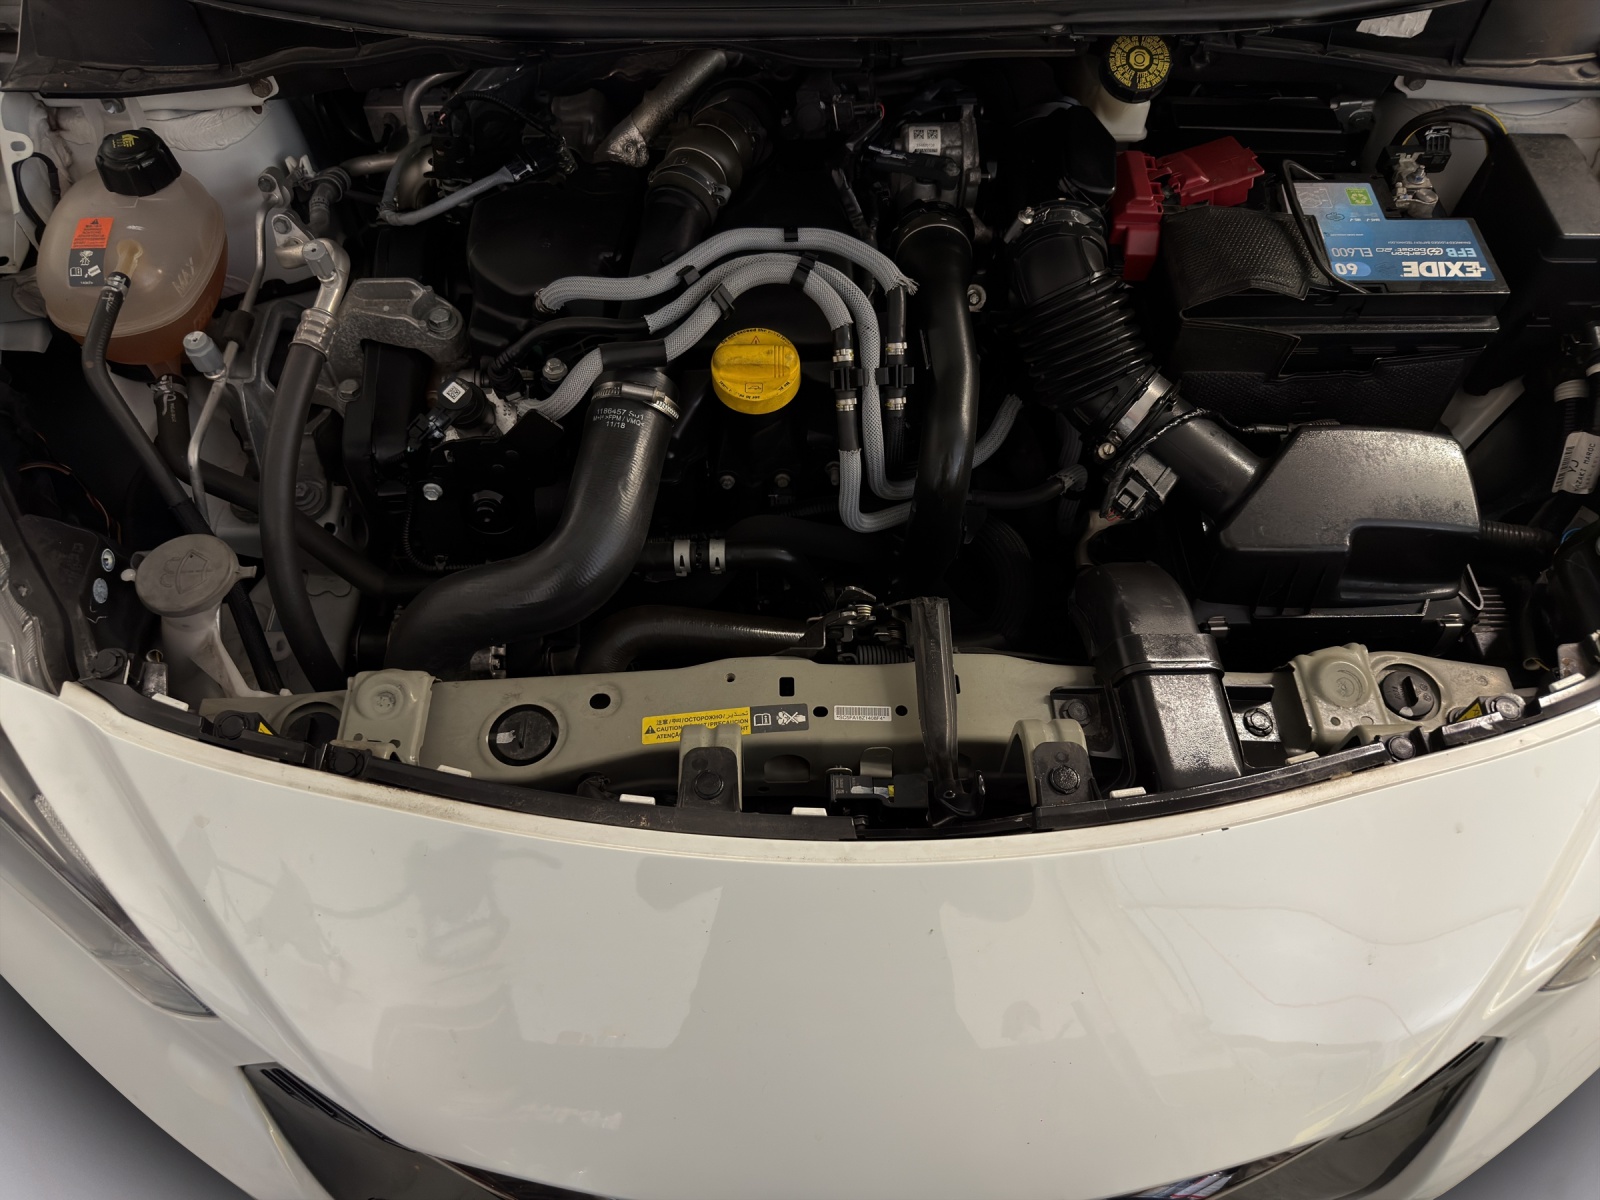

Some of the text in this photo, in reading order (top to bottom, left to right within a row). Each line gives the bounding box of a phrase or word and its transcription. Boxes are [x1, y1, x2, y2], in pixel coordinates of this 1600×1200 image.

[1331, 247, 1374, 257] EL600
[1445, 247, 1478, 258] EFB
[1335, 263, 1358, 275] 60
[1401, 261, 1487, 278] EXIDE
[606, 421, 626, 429] 11/18
[1583, 443, 1596, 464] MAROC
[656, 725, 682, 733] CAUTION
